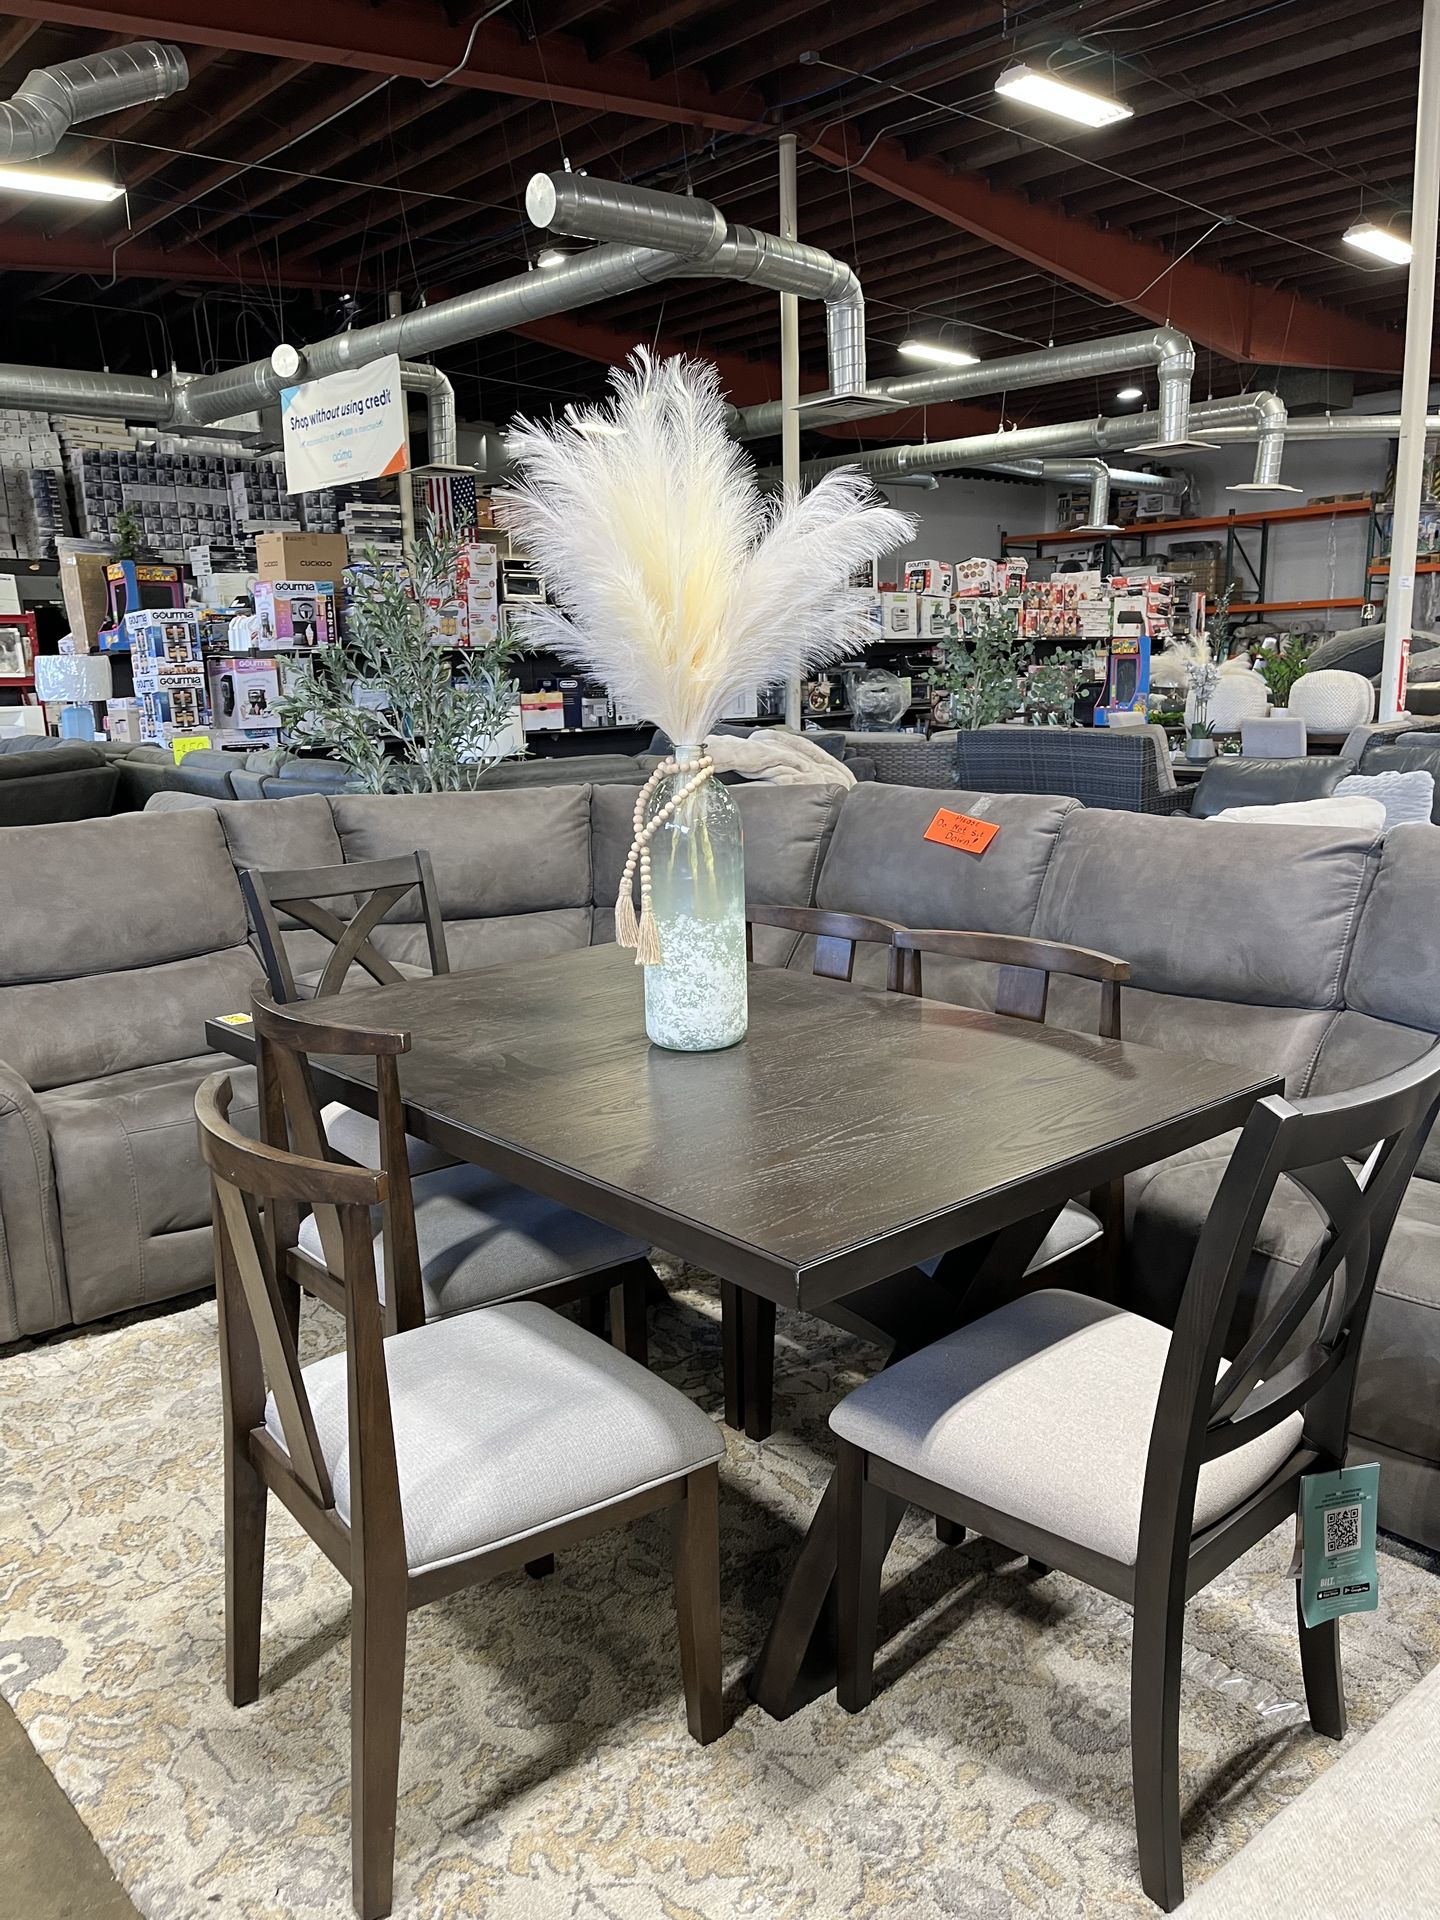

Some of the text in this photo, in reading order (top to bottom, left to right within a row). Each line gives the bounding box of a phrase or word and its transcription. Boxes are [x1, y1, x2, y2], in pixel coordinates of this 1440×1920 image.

[290, 389, 391, 431] Shop without using credit
[936, 818, 984, 838] Do Not Sit
[945, 832, 979, 846] Down!
